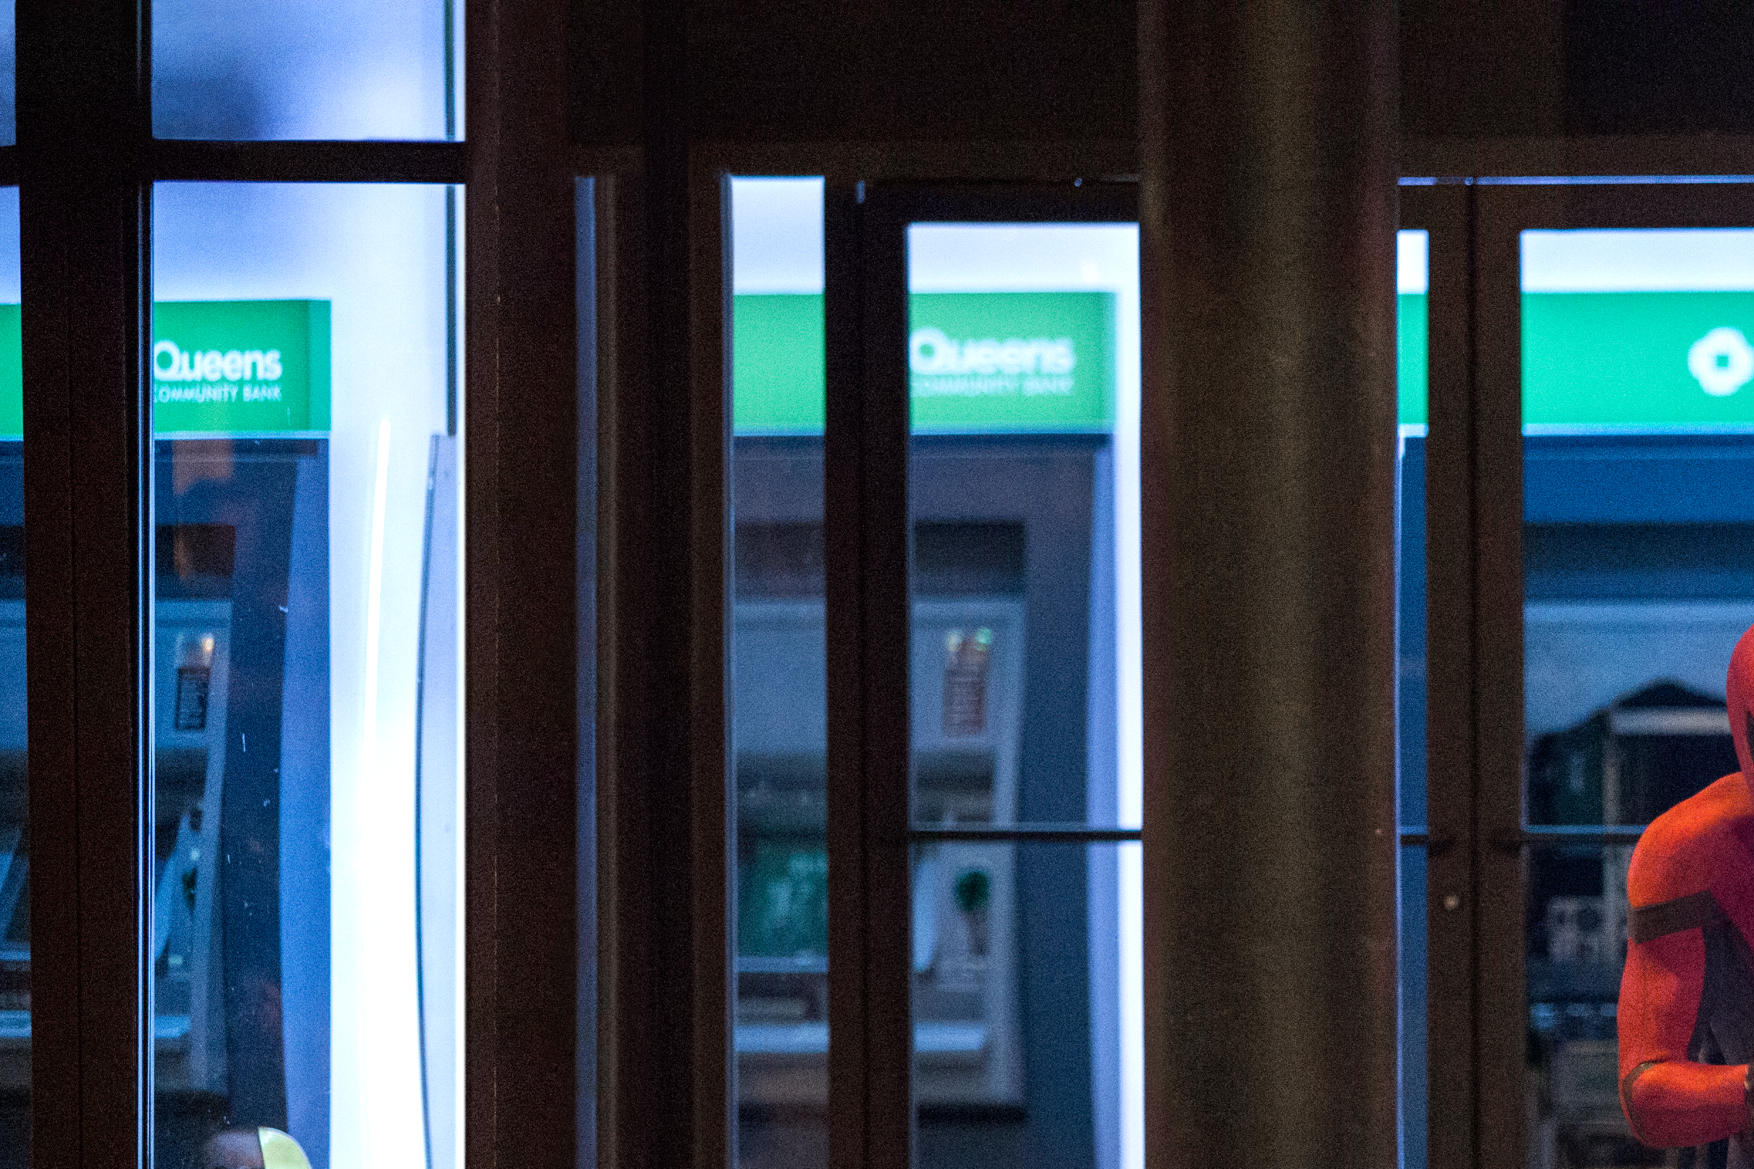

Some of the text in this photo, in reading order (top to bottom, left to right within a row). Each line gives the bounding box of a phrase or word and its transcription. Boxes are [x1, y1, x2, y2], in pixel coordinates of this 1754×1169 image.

[154, 340, 282, 381] Queens
[909, 327, 1075, 375] Queens
[243, 385, 282, 402] BANK
